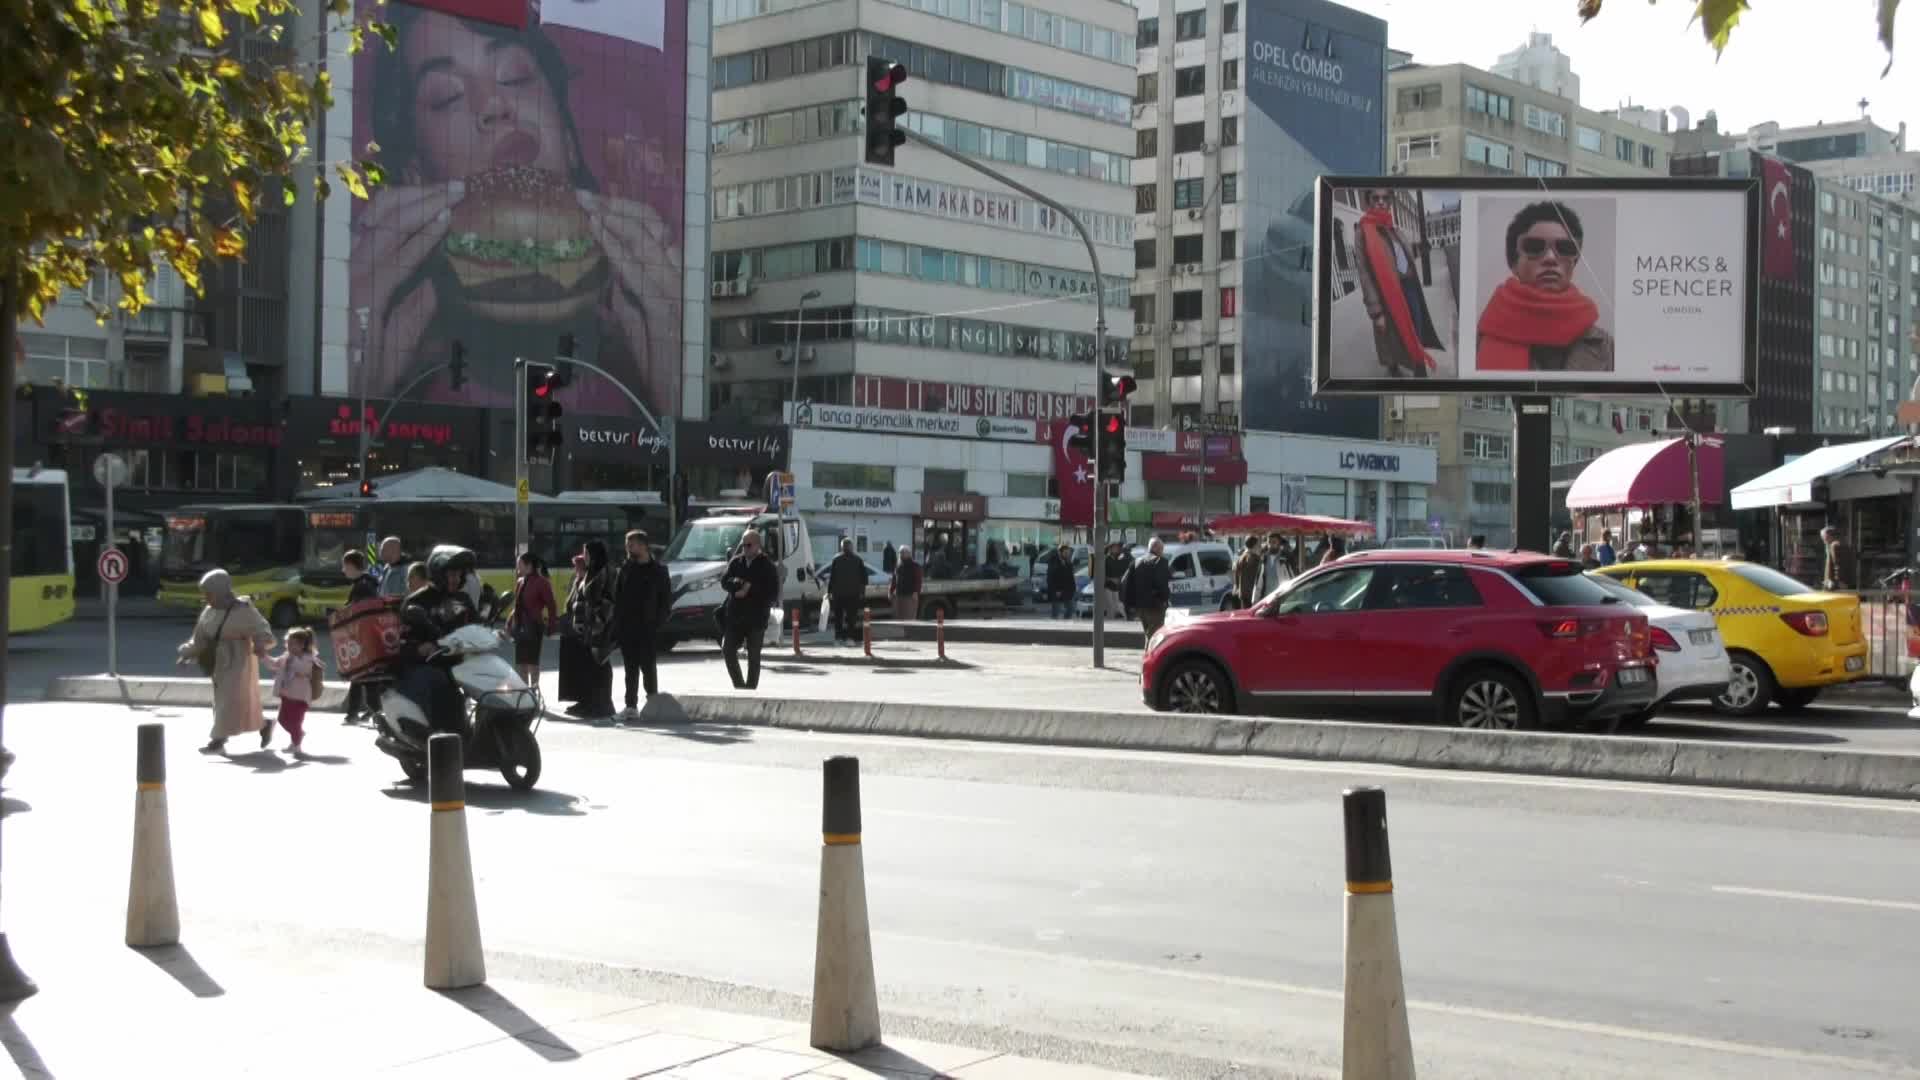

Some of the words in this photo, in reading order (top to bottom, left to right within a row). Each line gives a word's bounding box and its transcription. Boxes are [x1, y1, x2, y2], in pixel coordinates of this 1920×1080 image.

[1253, 40, 1289, 70] OPEL
[1293, 51, 1342, 84] COMBO
[894, 182, 931, 207] TAM
[1636, 255, 1710, 273] MARKS
[1714, 255, 1728, 273] &
[1631, 279, 1733, 297] SPENCER
[1662, 305, 1702, 314] LONDON
[916, 416, 960, 432] merkezi
[834, 496, 863, 506] Garanti
[865, 496, 892, 508] BBVA
